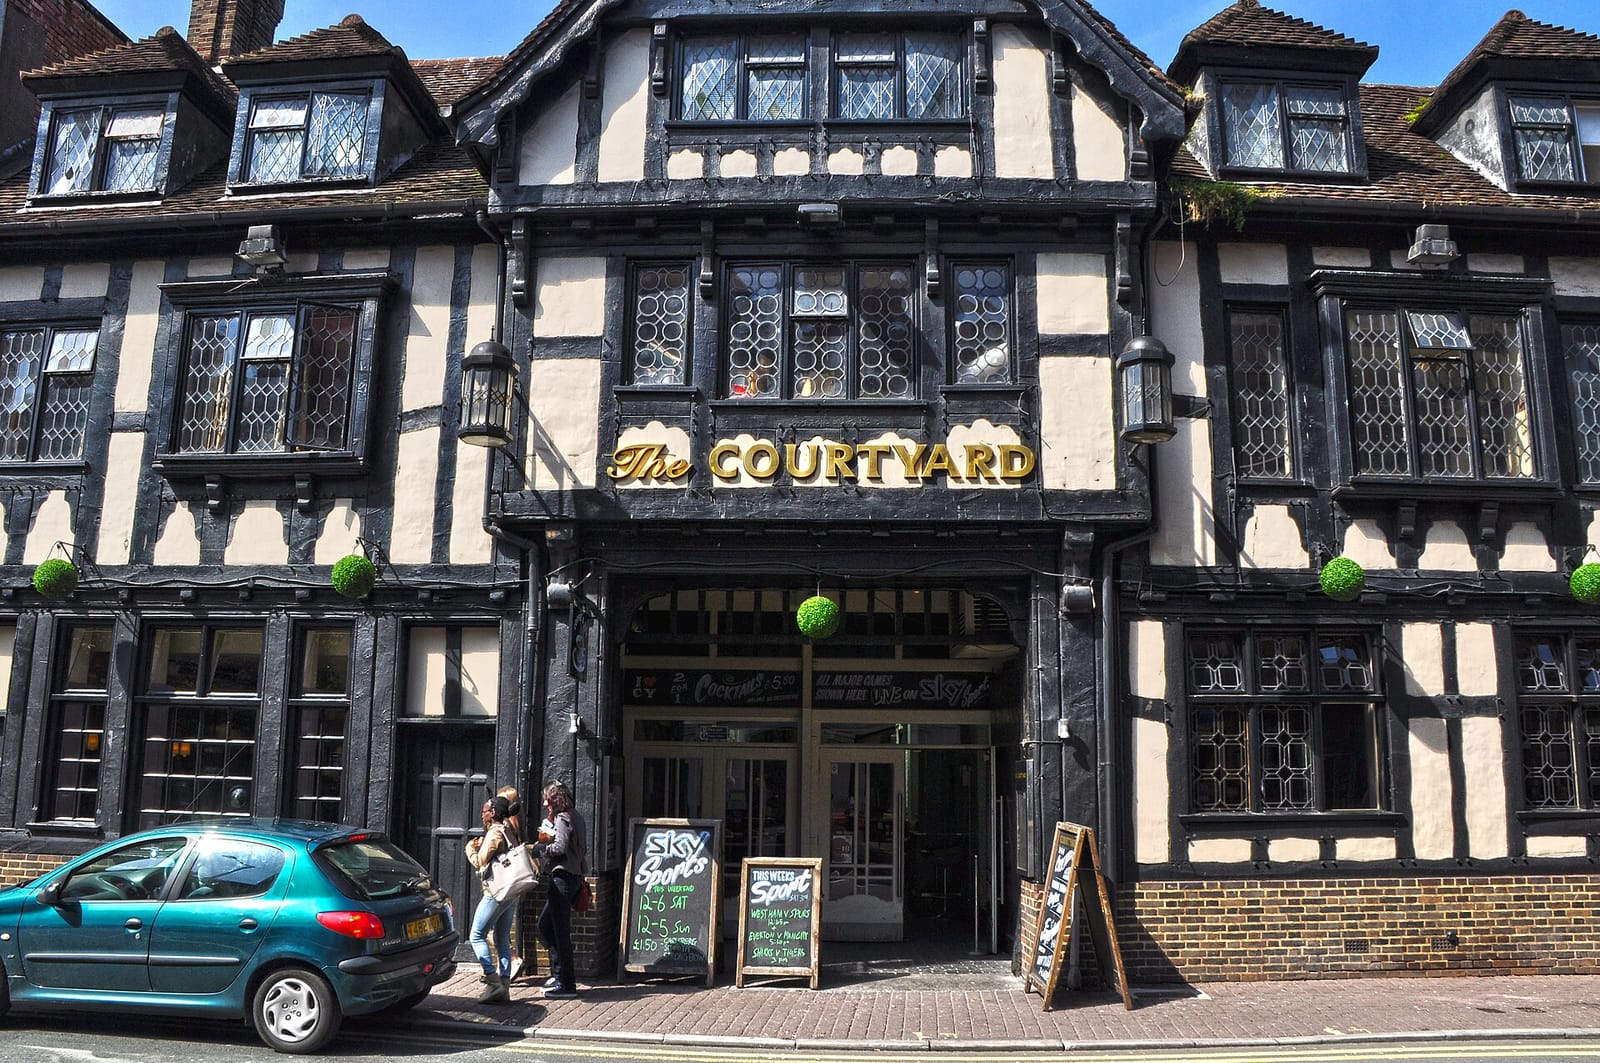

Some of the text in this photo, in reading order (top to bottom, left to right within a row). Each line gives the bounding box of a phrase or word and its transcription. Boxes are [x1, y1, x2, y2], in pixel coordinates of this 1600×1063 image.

[606, 442, 1036, 480] The COURTYARD
[673, 672, 686, 683] 2
[832, 674, 864, 686] MAJOR
[864, 674, 893, 686] GAMES
[632, 688, 656, 698] CY
[671, 683, 688, 693] FOR
[846, 689, 869, 701] HERE
[873, 686, 902, 706] LIVE
[903, 689, 918, 700] ON
[634, 855, 708, 893] Sports
[752, 870, 795, 881] THIS WEEKS
[751, 869, 812, 906] Sport
[639, 895, 688, 912] 12-6 SAT
[751, 908, 768, 919] WEST
[768, 909, 783, 918] HAM
[789, 908, 810, 918] SPURS
[638, 915, 668, 937] 12-5
[749, 931, 774, 941] EVERTON
[633, 938, 657, 951] £1.50
